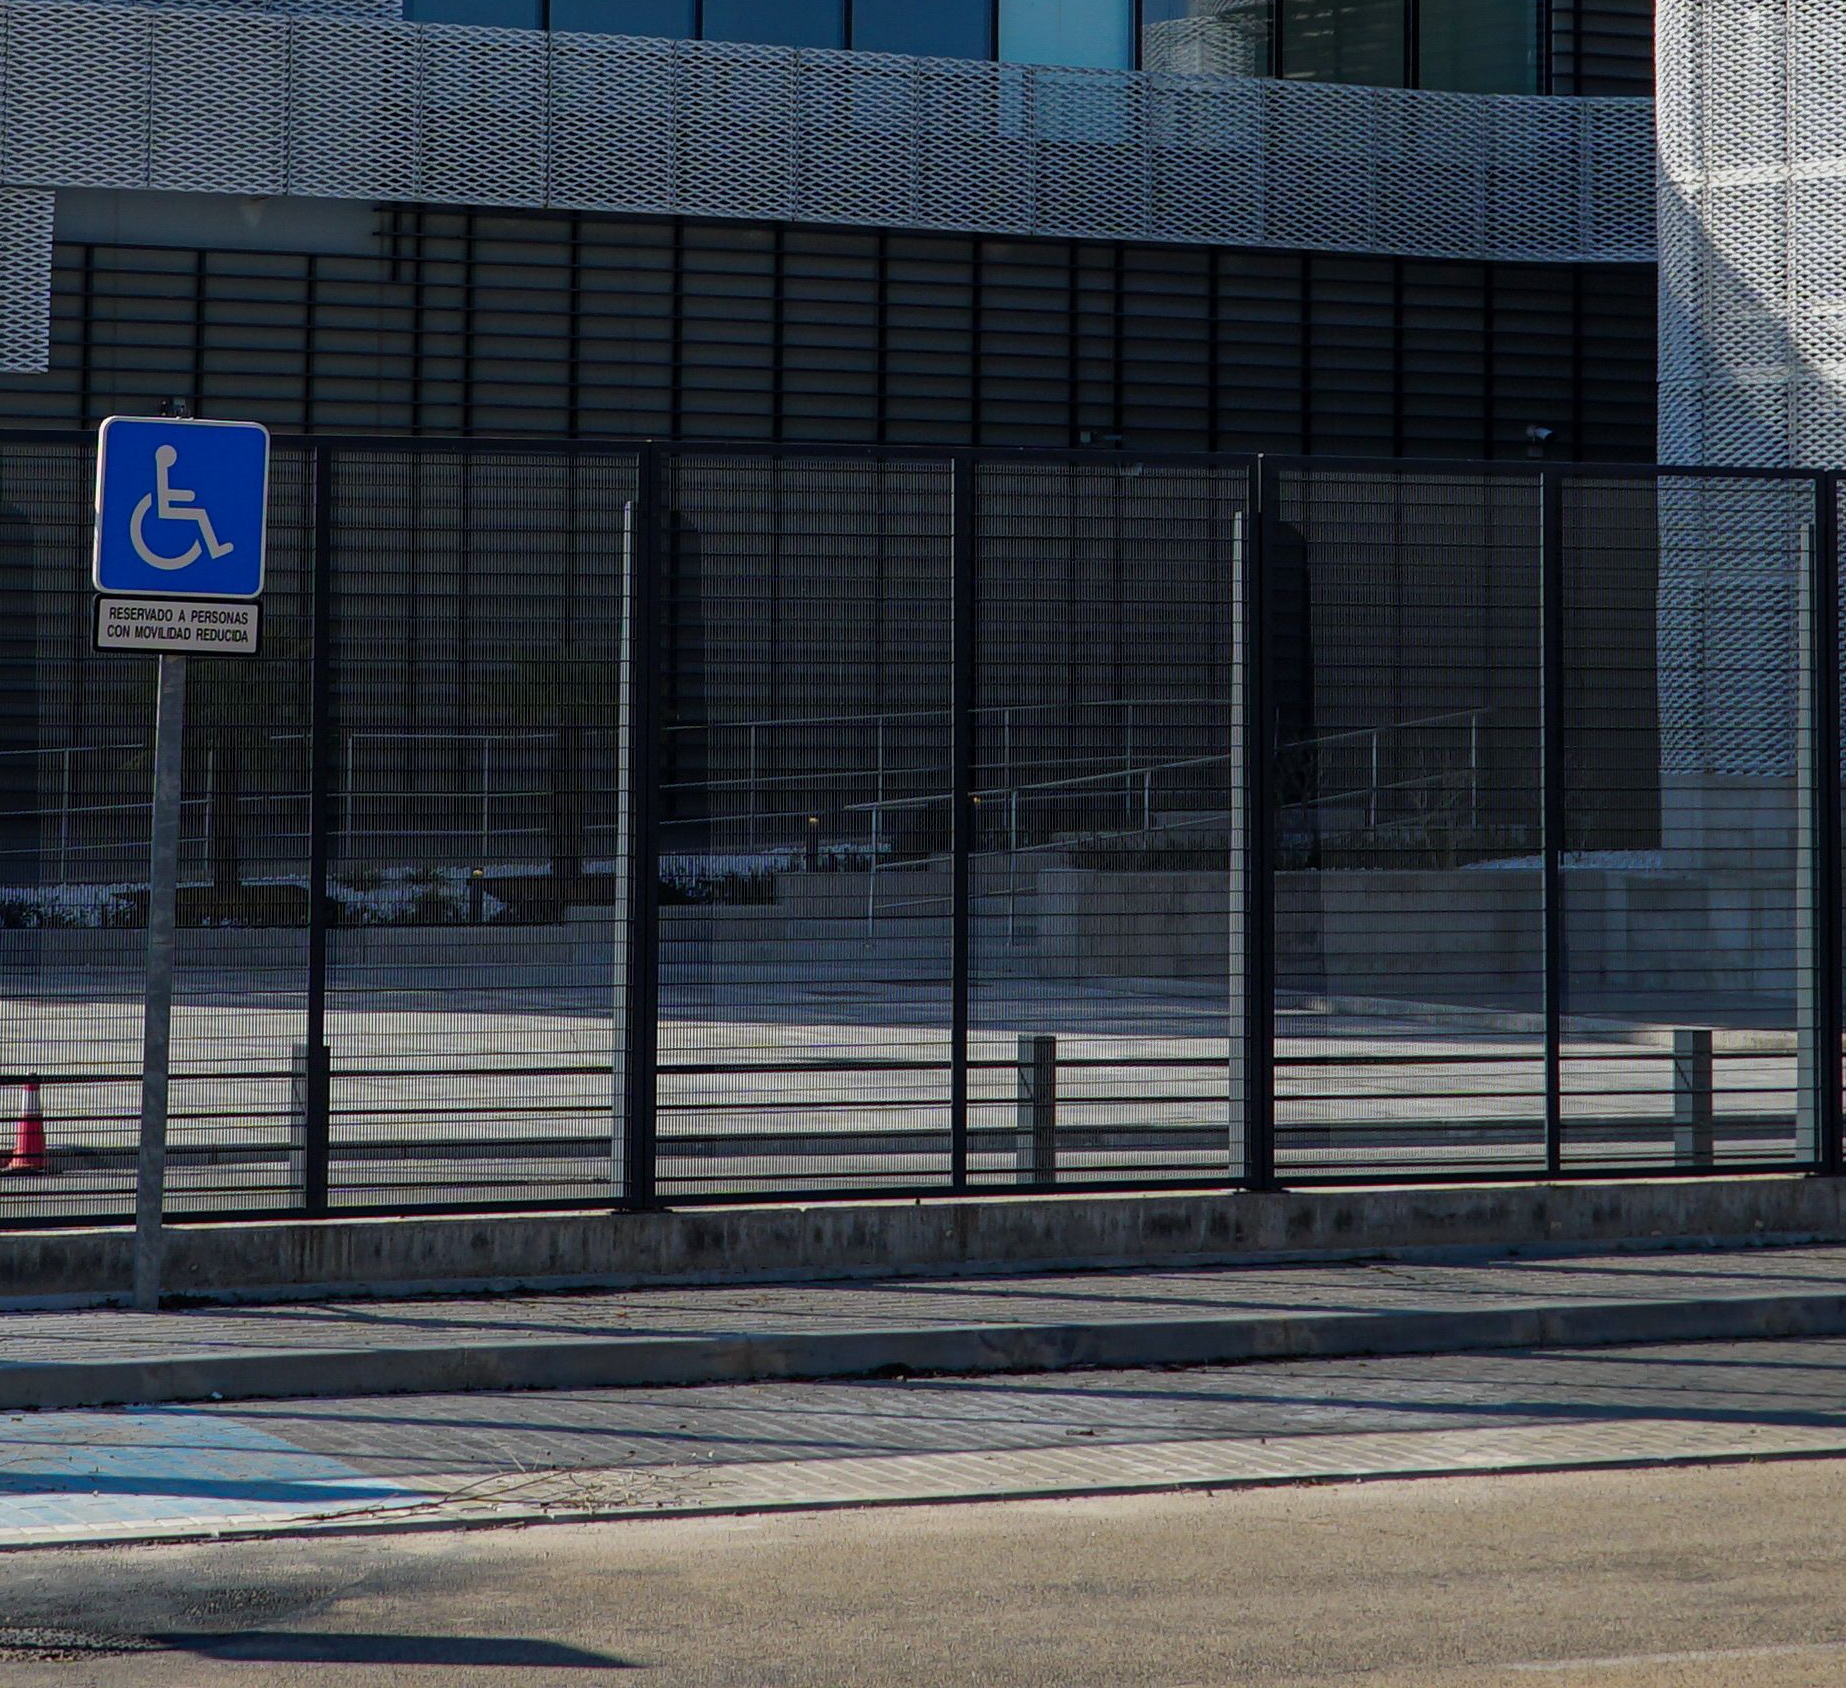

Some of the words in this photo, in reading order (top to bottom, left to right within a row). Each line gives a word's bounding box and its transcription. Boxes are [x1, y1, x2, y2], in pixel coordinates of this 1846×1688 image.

[109, 607, 173, 622] RESERVADO
[178, 609, 186, 622] A
[191, 610, 248, 625] PERSONAS
[107, 625, 130, 638] CON
[135, 626, 191, 640] MOVILIDAD
[196, 628, 248, 642] REDUCIDA
